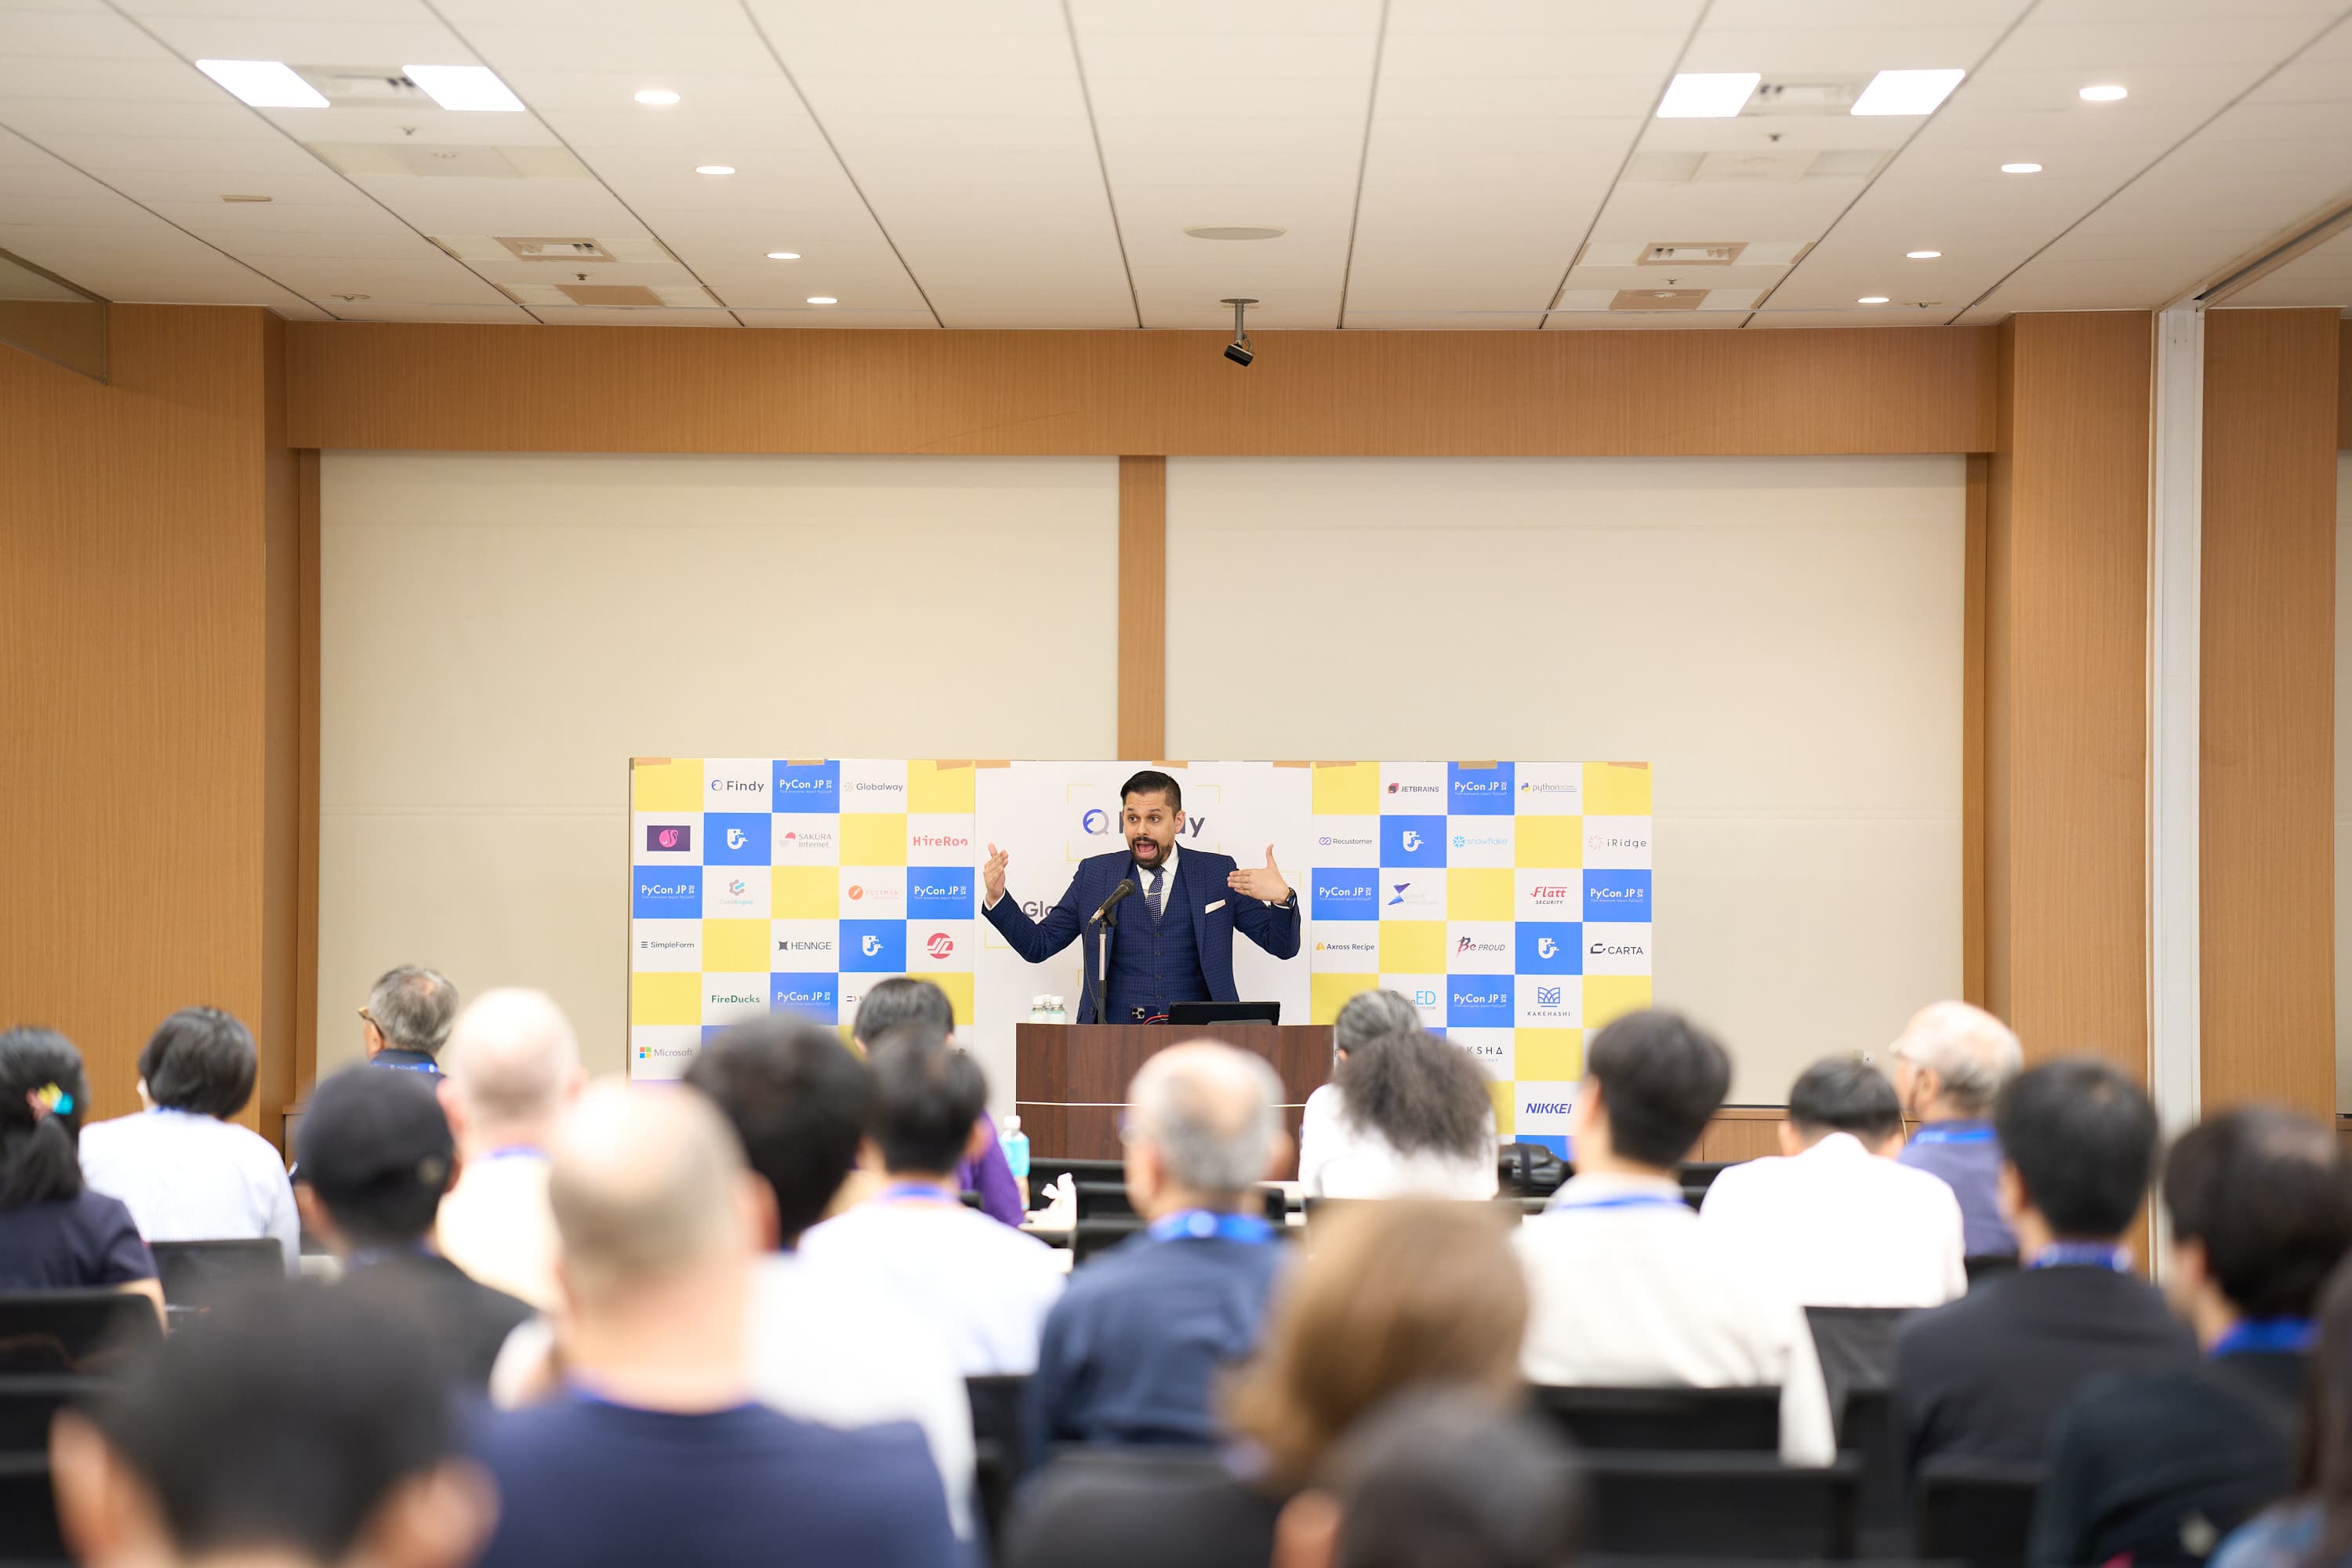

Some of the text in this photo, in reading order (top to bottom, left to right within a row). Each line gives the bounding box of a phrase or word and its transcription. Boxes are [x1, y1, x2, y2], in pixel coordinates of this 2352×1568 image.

[727, 781, 764, 793] Findy
[779, 779, 811, 790] PyCon
[814, 779, 824, 789] JP
[856, 782, 903, 792] Globalway
[1454, 781, 1486, 792] PyCon
[1489, 781, 1499, 790] JP
[1533, 782, 1560, 793] python
[1467, 837, 1507, 845] snowflake
[1607, 838, 1647, 849] iRidge
[641, 885, 673, 896] PyCon
[676, 885, 686, 894] JP
[914, 886, 946, 897] PyCon
[949, 886, 959, 895] JP
[1319, 887, 1350, 898] PyCon
[1353, 887, 1363, 896] JP
[1530, 886, 1567, 898] Flatt
[1590, 888, 1621, 899] PyCon
[1624, 888, 1635, 897] JP
[651, 941, 695, 949] SimpleForm
[791, 942, 832, 950] HENNGE
[1352, 943, 1375, 952] Recipe
[1607, 946, 1644, 955] CARTA
[711, 994, 760, 1004] FireDucks
[778, 992, 809, 1003] PyCon
[812, 992, 822, 1000] JP
[1454, 993, 1485, 1004] PyCon
[1488, 993, 1498, 1003] JP
[654, 1048, 692, 1057] Microsoft
[1526, 1103, 1572, 1114] NIKKEI
